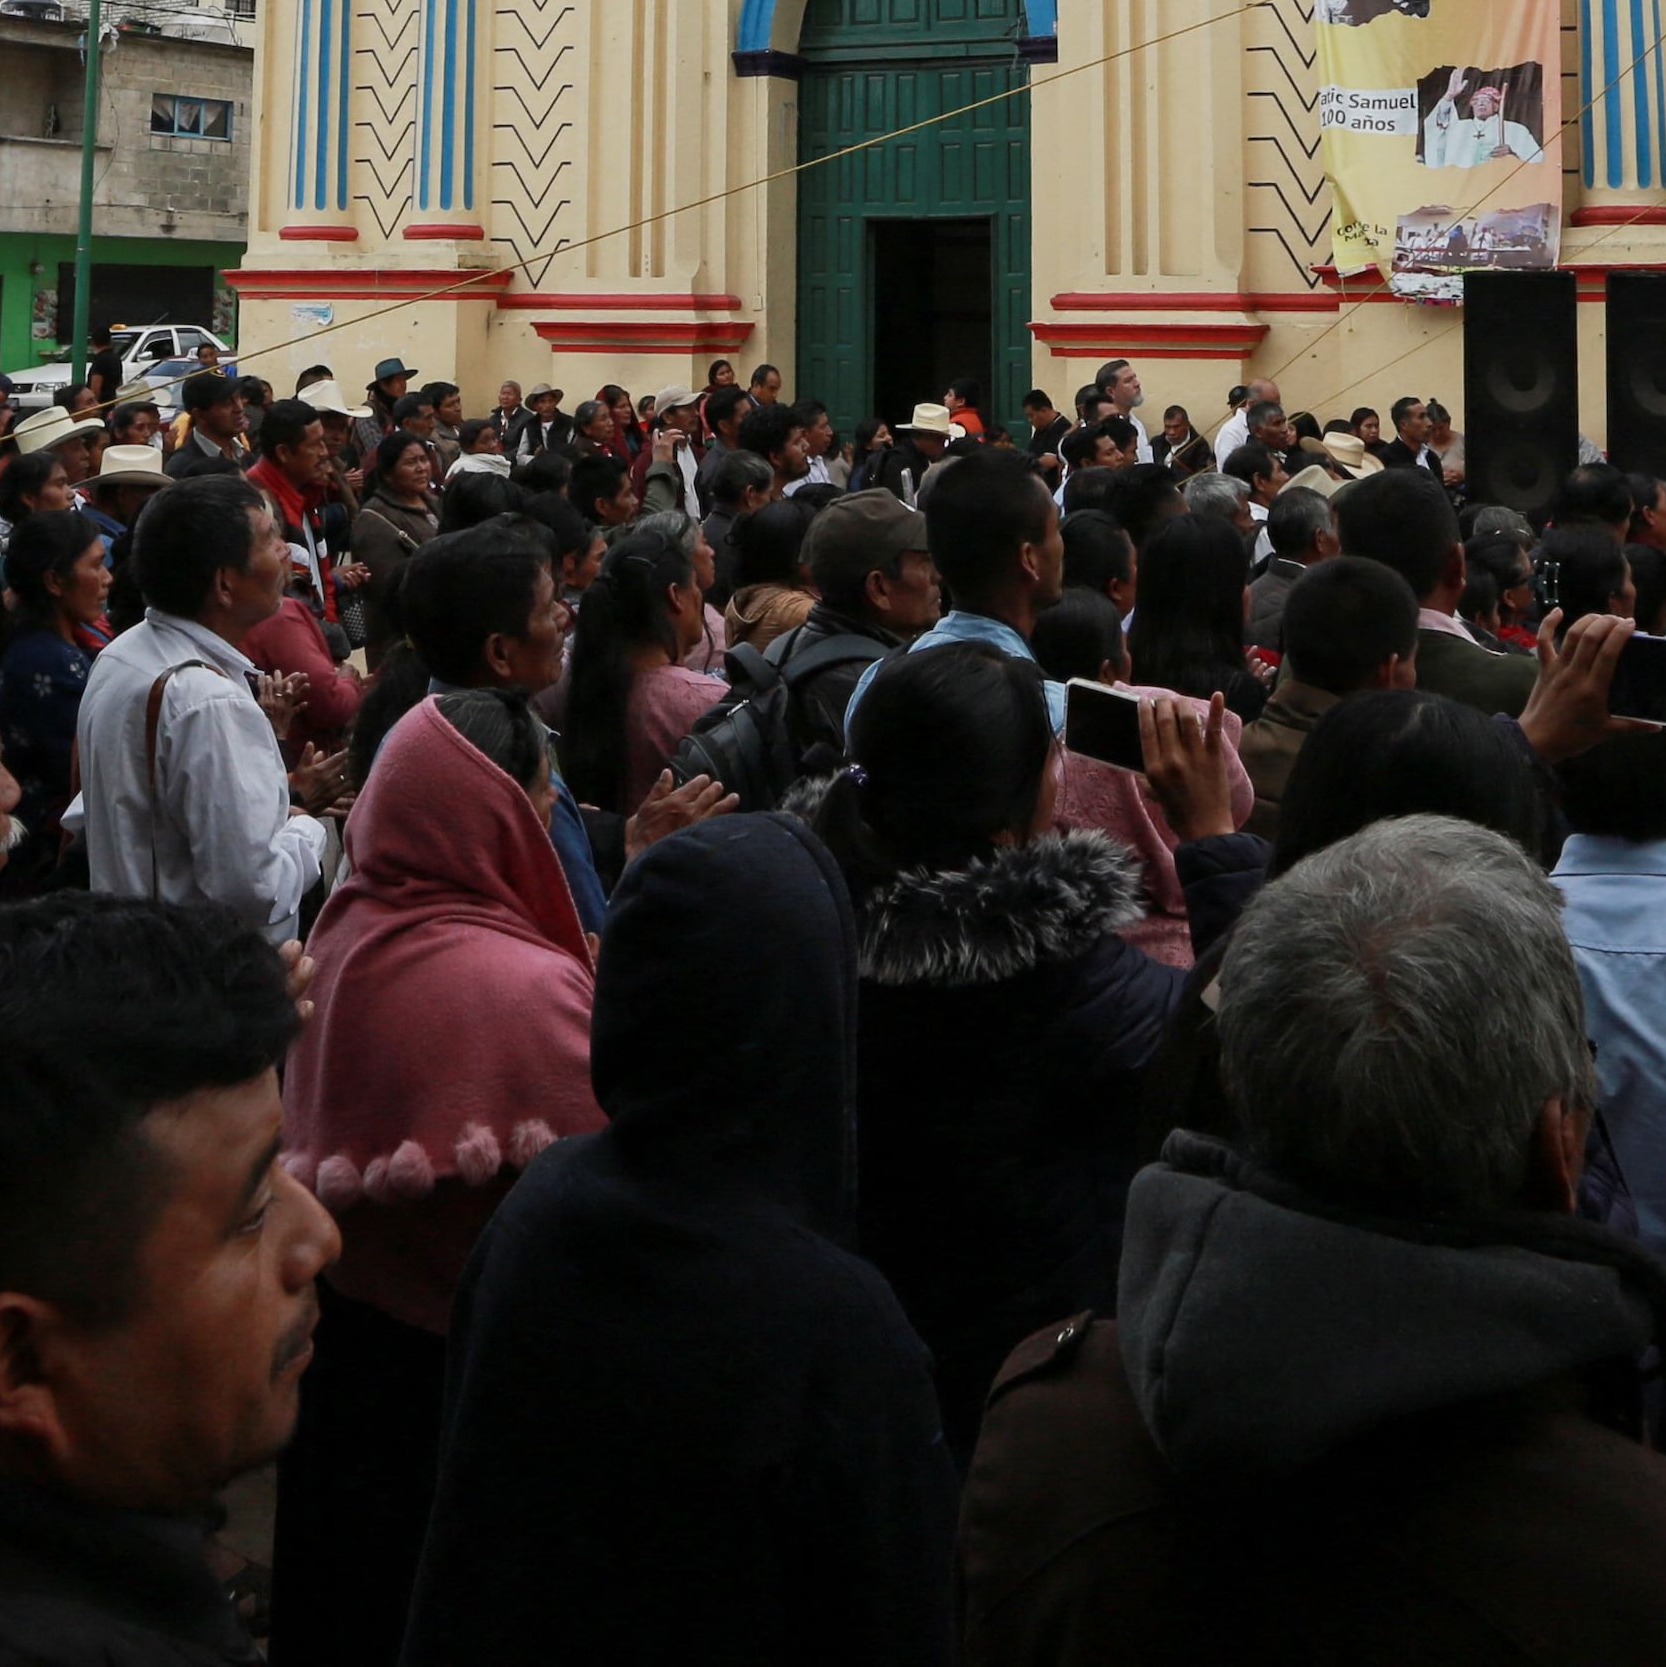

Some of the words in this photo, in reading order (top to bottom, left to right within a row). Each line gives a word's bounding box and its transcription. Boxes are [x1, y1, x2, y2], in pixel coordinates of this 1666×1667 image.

[1320, 88, 1343, 105] atic
[1348, 93, 1416, 110] Samuel
[1322, 109, 1346, 126] 100
[1351, 114, 1395, 131] años
